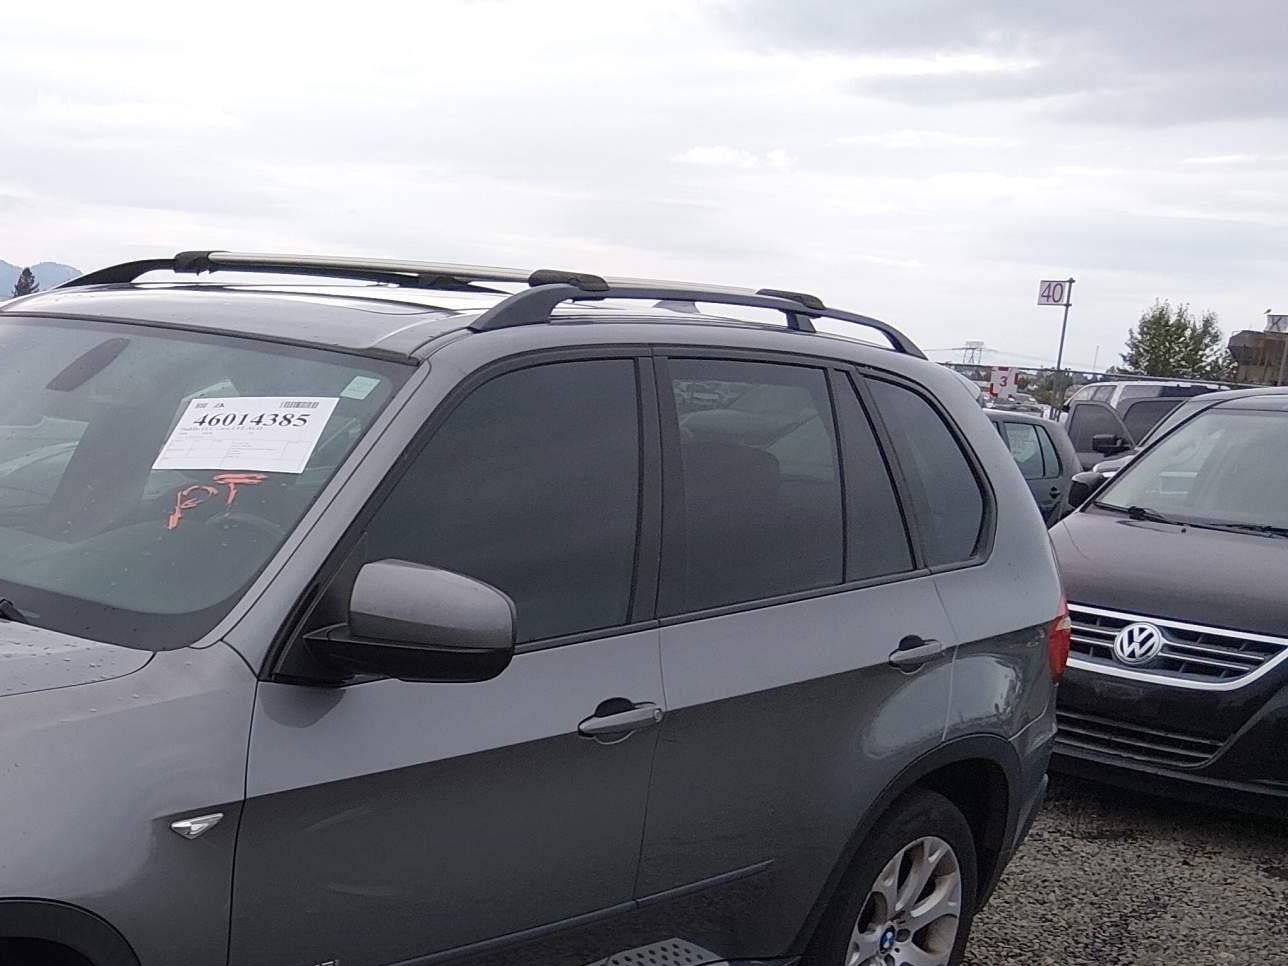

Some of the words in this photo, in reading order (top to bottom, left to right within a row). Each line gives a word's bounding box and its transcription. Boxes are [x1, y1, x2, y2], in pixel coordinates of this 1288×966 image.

[1040, 282, 1064, 303] 40
[999, 376, 1008, 387] 3
[193, 412, 312, 428] 46014385
[1116, 623, 1159, 662] VW
